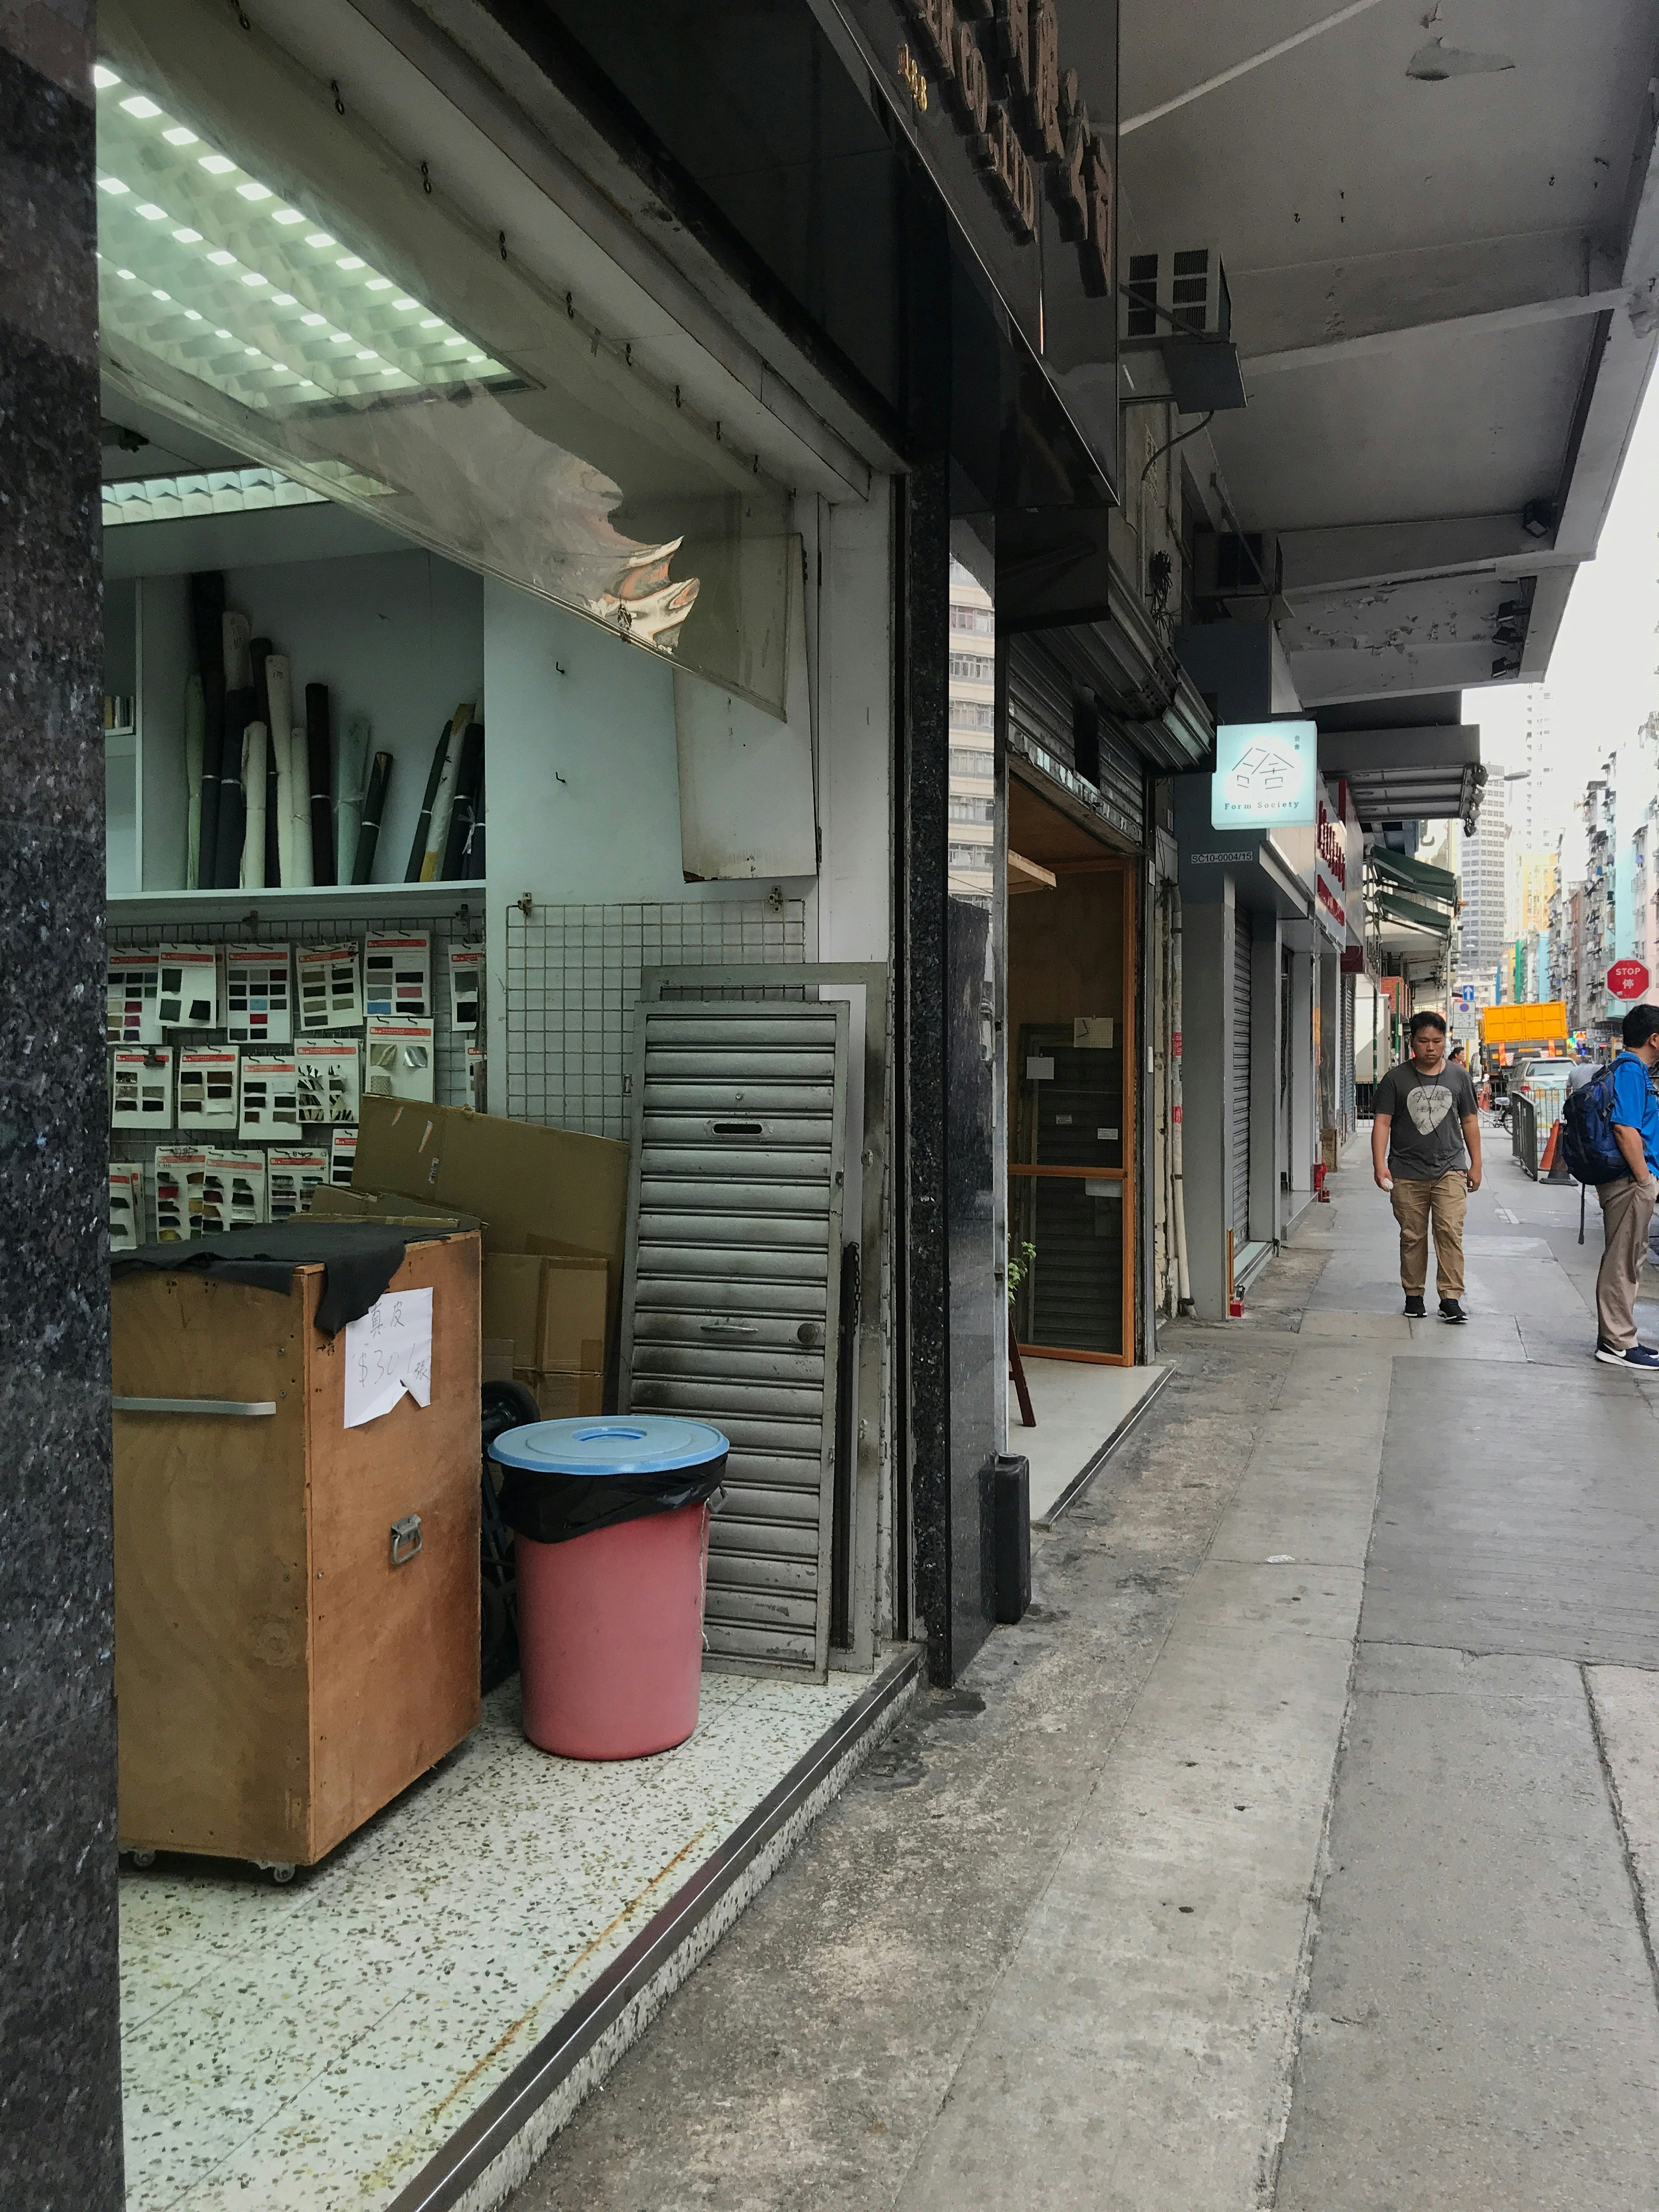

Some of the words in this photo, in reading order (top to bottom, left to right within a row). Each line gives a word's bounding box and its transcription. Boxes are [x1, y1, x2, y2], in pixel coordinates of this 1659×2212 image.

[1192, 853, 1252, 863] SC10-0004/15
[1615, 967, 1640, 975] STOP
[1622, 978, 1634, 989] 停
[370, 1300, 404, 1339] 真皮
